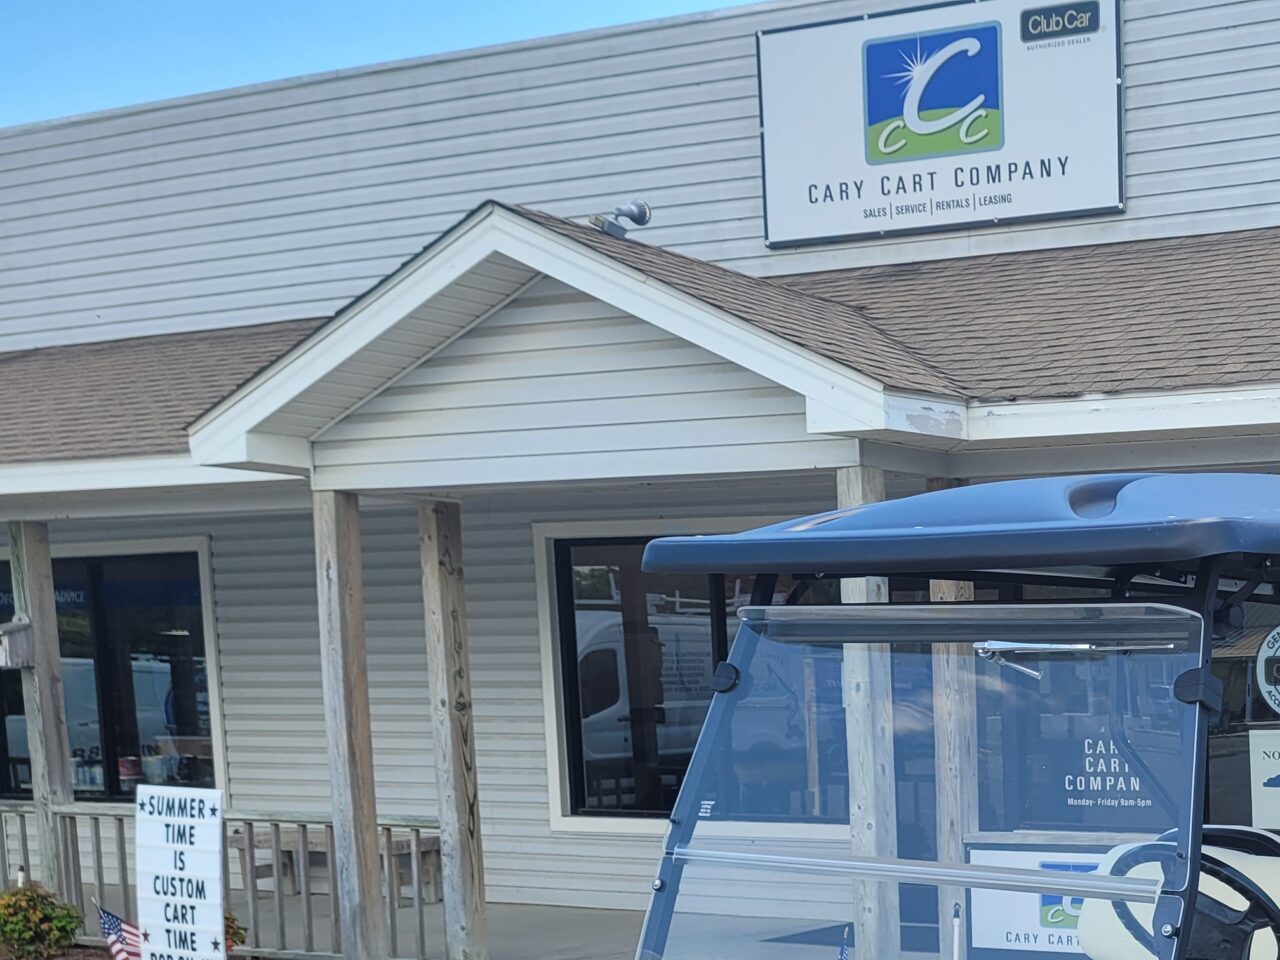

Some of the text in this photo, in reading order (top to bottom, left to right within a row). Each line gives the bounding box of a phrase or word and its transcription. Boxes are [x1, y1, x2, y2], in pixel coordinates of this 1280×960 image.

[1028, 10, 1092, 34] Club Car
[1027, 37, 1091, 51] AUTHORIZED DEALER
[808, 155, 1070, 204] CARY CART COMPANY
[863, 193, 1013, 219] SALES SERVICE RENTALS LEASING
[1065, 775, 1140, 791] COMPAN
[148, 796, 205, 820] SUMMER
[1067, 797, 1152, 808] Monday- Friday 9am-5pm
[164, 823, 195, 846] TIME
[174, 850, 185, 871] IS
[153, 876, 206, 900] CUSTOM
[164, 903, 195, 926] CART
[165, 929, 197, 951] TIME
[1006, 931, 1039, 945] CARY
